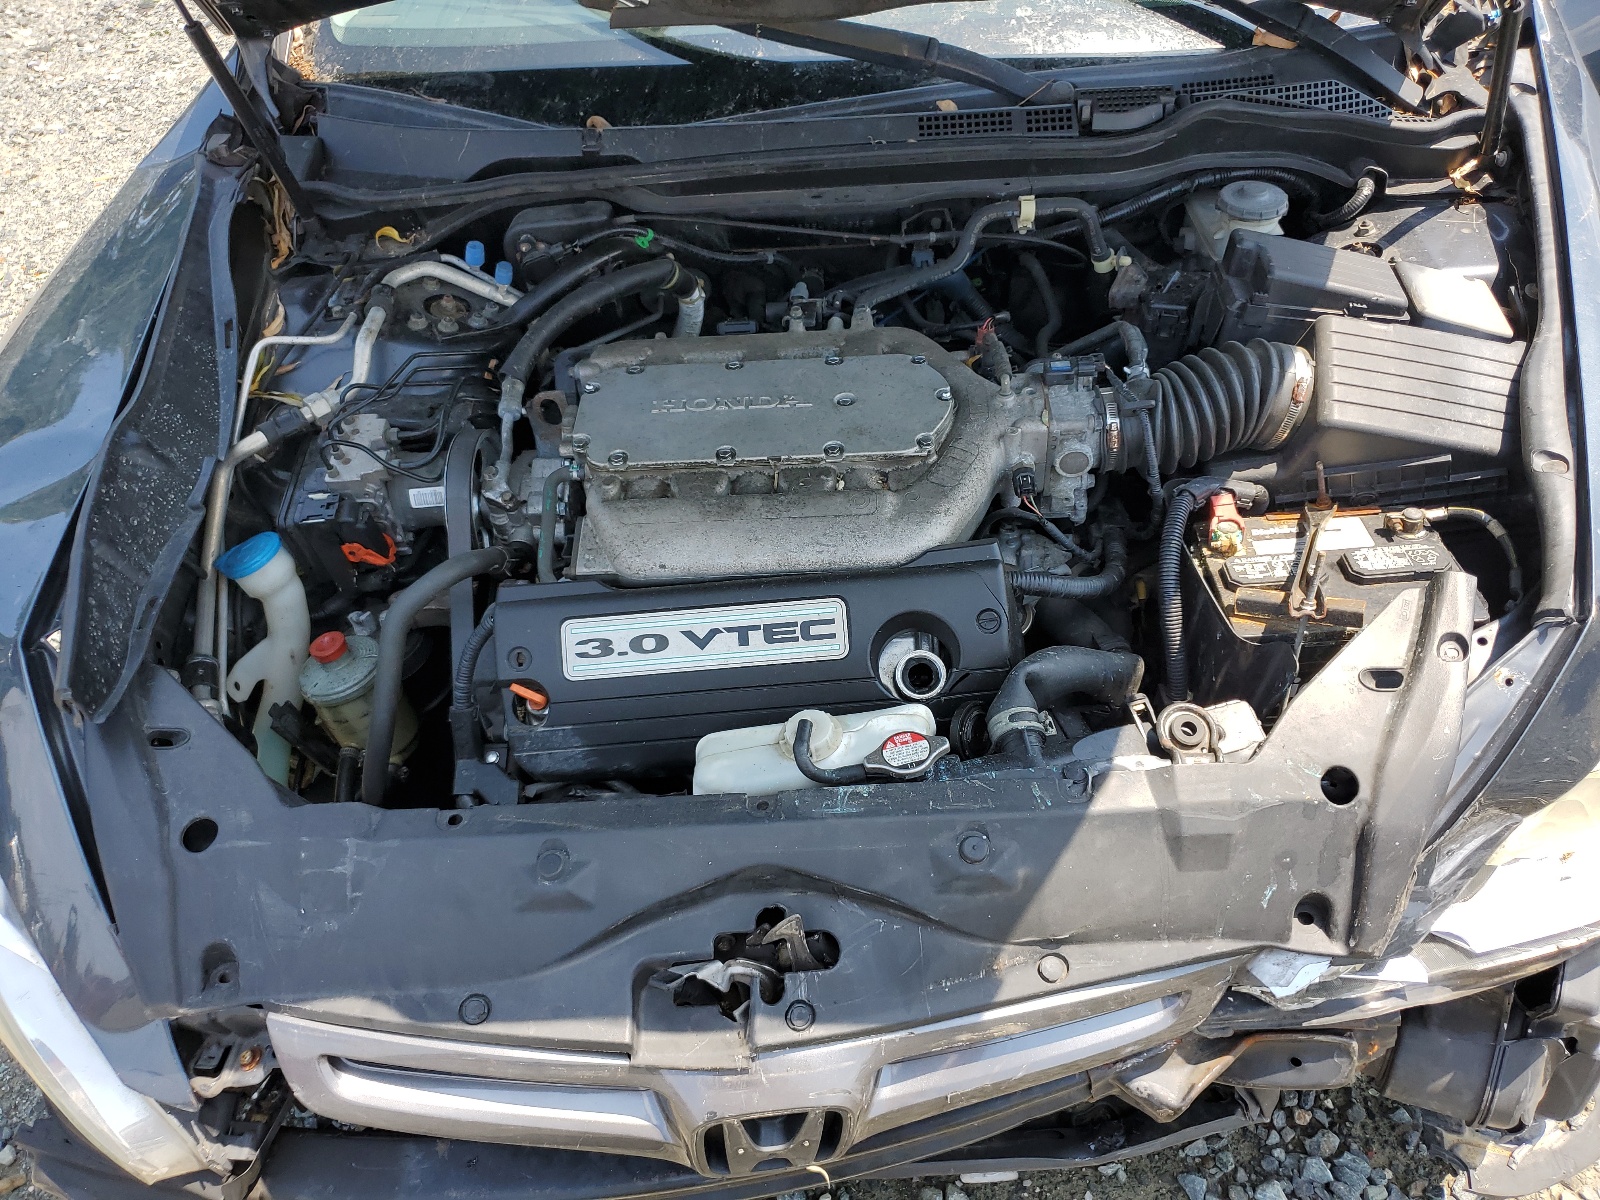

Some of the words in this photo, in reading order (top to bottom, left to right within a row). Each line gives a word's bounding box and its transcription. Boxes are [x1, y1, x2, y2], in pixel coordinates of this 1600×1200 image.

[650, 394, 814, 414] HONDA
[574, 633, 670, 659] 3.0
[680, 618, 838, 651] VTEC
